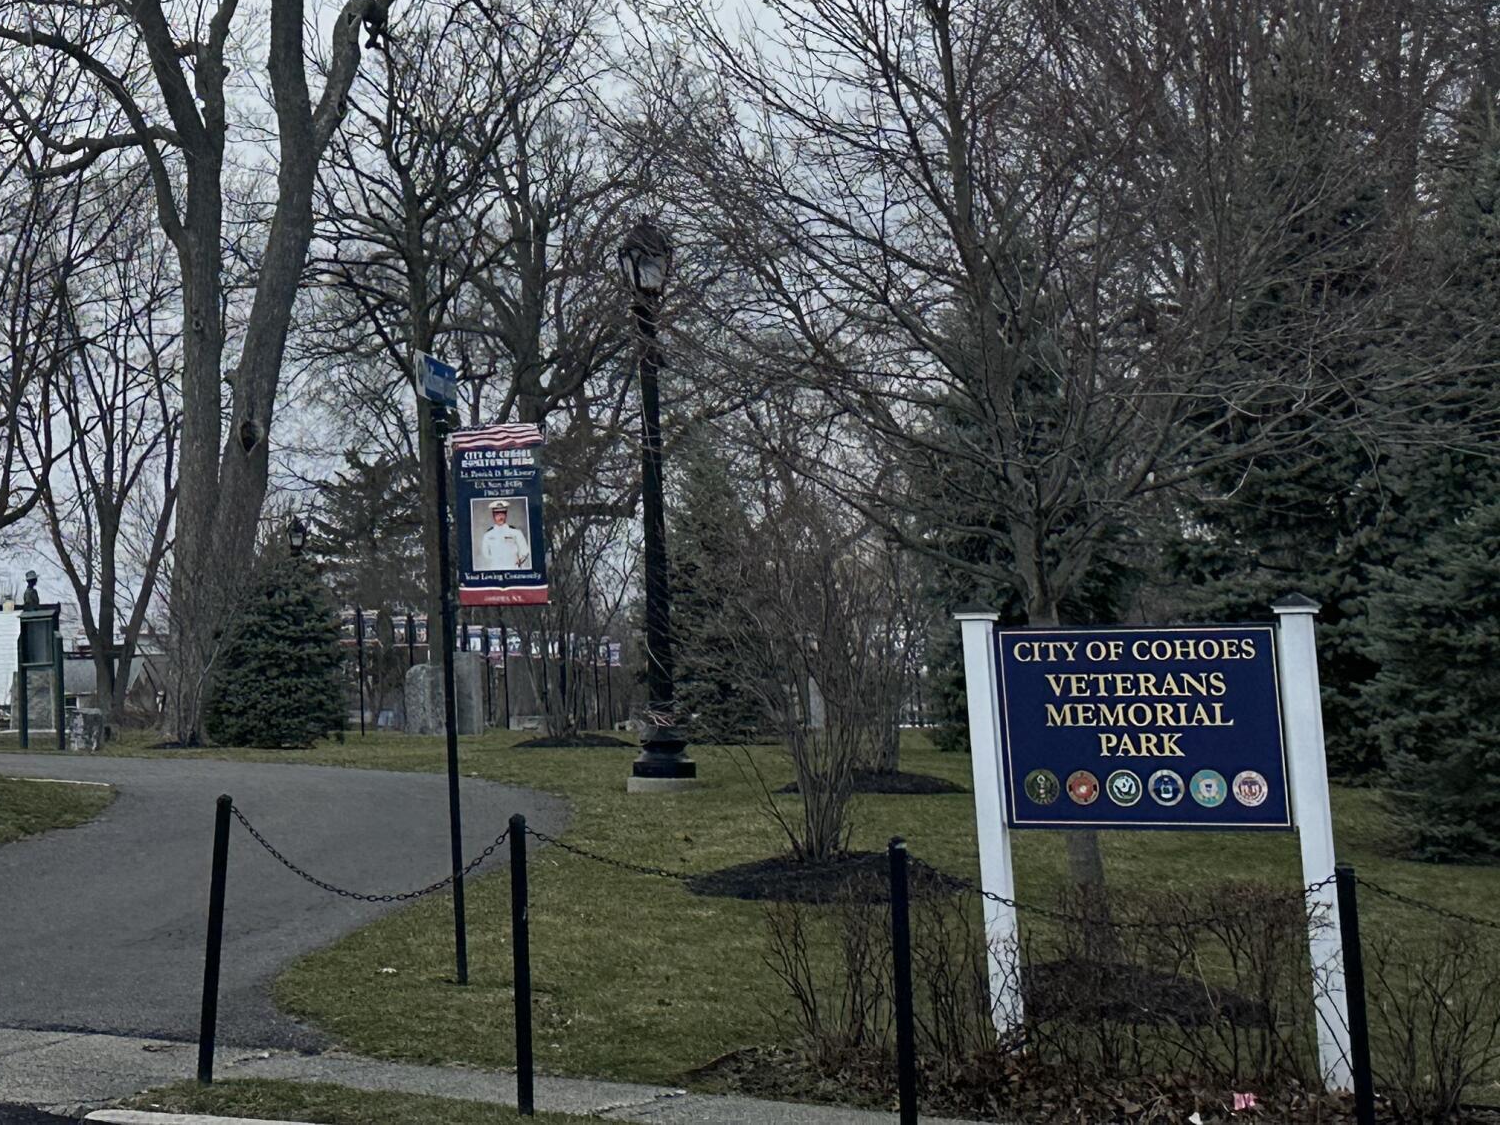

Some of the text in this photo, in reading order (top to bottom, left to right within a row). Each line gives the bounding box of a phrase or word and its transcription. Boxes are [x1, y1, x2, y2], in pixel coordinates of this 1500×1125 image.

[1013, 639, 1256, 662] CITY OF COHOES
[1045, 672, 1227, 697] VETERANS
[1045, 702, 1234, 726] MEMORIAL
[1098, 733, 1185, 757] PARK
